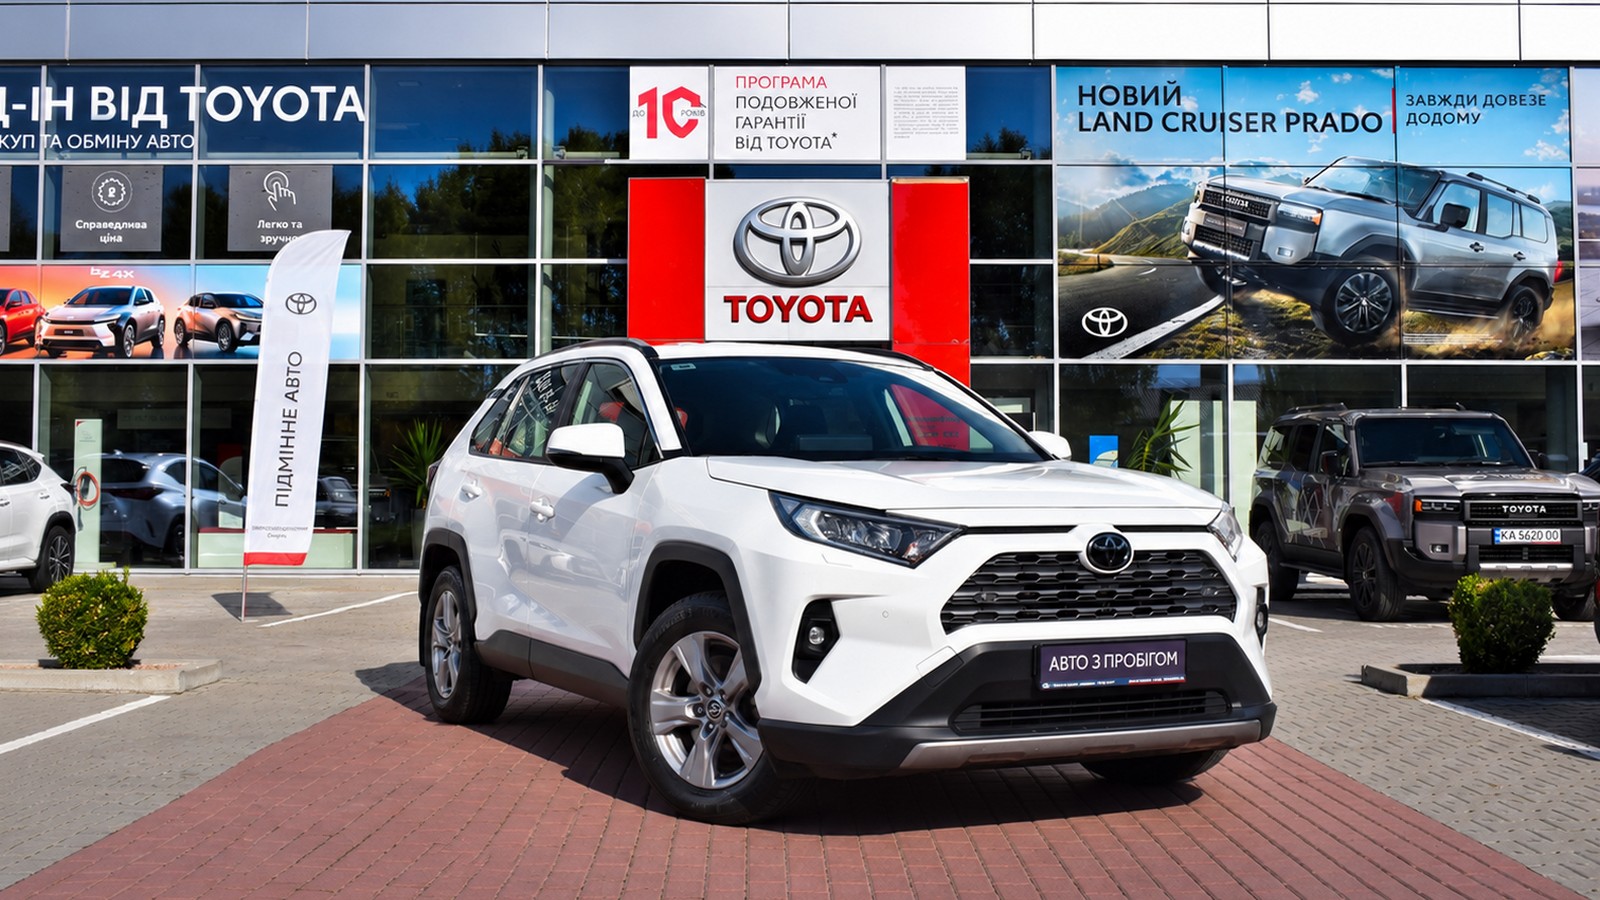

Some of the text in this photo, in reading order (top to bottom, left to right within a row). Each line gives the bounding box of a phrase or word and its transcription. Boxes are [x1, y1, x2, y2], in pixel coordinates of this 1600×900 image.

[735, 75, 828, 89] ПРОГРАМА
[1078, 80, 1182, 106] НОВИЙ
[90, 86, 168, 129] ВІД
[179, 85, 366, 122] TOYOTA
[735, 93, 858, 112] ПОДОВЖЕНОЇ
[1405, 94, 1547, 109] ЗАВЖДИ ДОВЕЗЕ
[1078, 111, 1383, 133] LAND CRUISER PRADO
[1405, 112, 1481, 127] ДОДОМУ
[40, 134, 63, 149] ТА
[67, 134, 142, 149] ОБМІНУ
[146, 134, 195, 149] АВТО
[75, 219, 148, 231] Справедлива
[256, 219, 303, 229] Легко та
[99, 232, 123, 244] ціна
[723, 294, 874, 324] TOYOTA
[284, 351, 303, 403] АВТО
[274, 408, 298, 507] ПІДМІННЕ
[1502, 504, 1547, 514] TOYOTA
[1500, 530, 1559, 541] KA 5620 00
[1049, 650, 1178, 672] АВТО З ПРОБІГОМ
